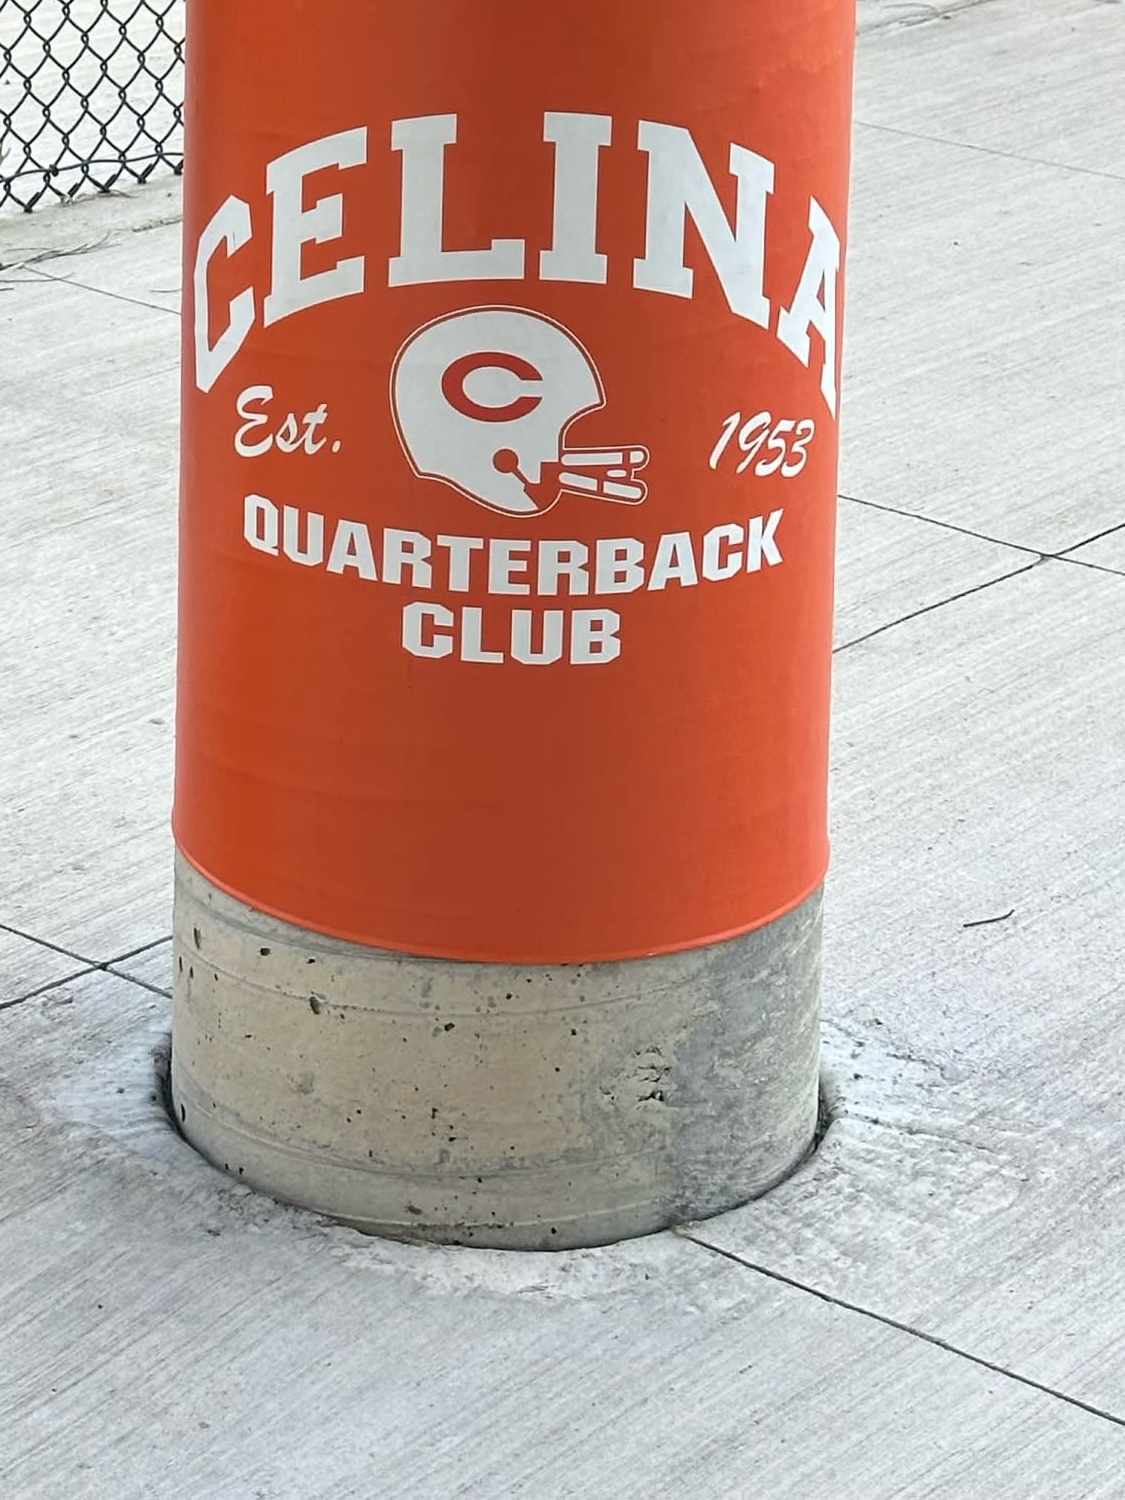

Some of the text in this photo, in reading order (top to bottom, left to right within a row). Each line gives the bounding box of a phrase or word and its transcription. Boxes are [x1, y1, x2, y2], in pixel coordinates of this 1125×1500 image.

[194, 111, 841, 420] CELINA
[235, 386, 815, 476] Est. 1953
[441, 351, 543, 422] C
[243, 493, 784, 596] QUARTERBACK
[402, 601, 622, 665] CLUB
